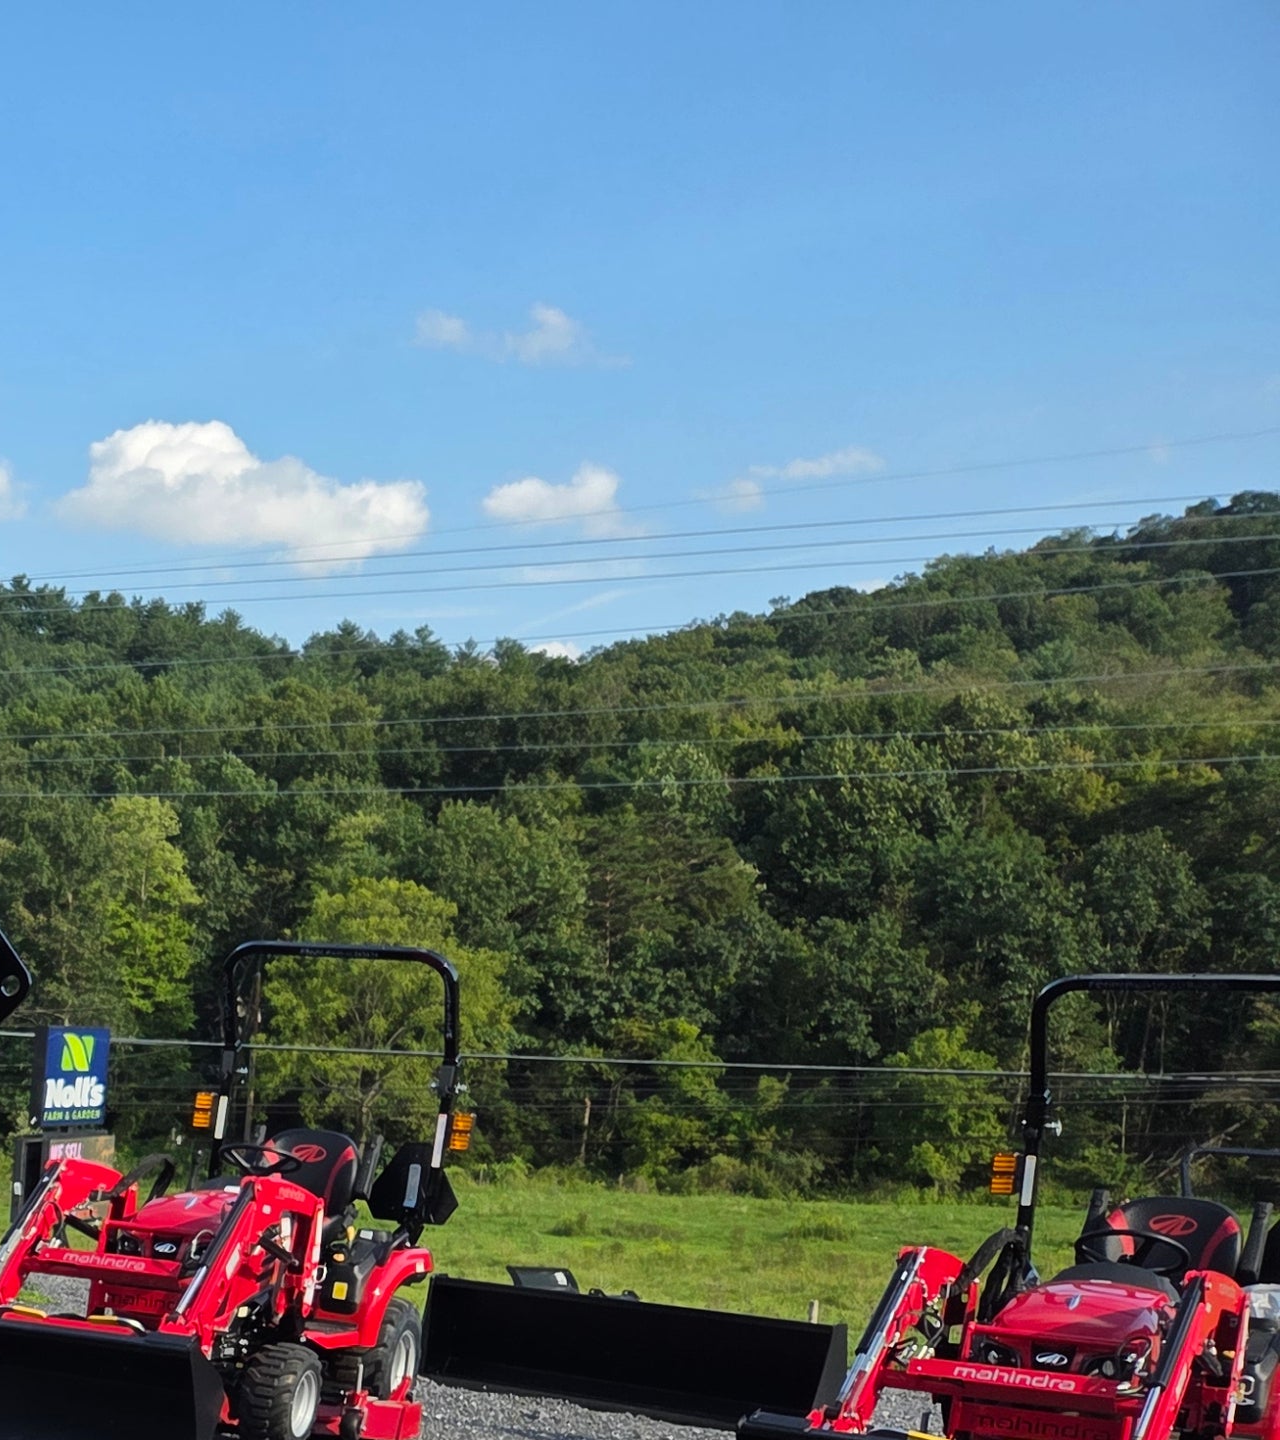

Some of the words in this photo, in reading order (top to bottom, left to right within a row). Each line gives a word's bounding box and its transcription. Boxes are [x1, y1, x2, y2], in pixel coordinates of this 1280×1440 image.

[44, 1076, 105, 1110] Noll's
[43, 1110, 63, 1121] FARM
[71, 1109, 101, 1120] GARDEN
[62, 1252, 146, 1272] mahindra
[953, 1366, 1076, 1391] mahindra
